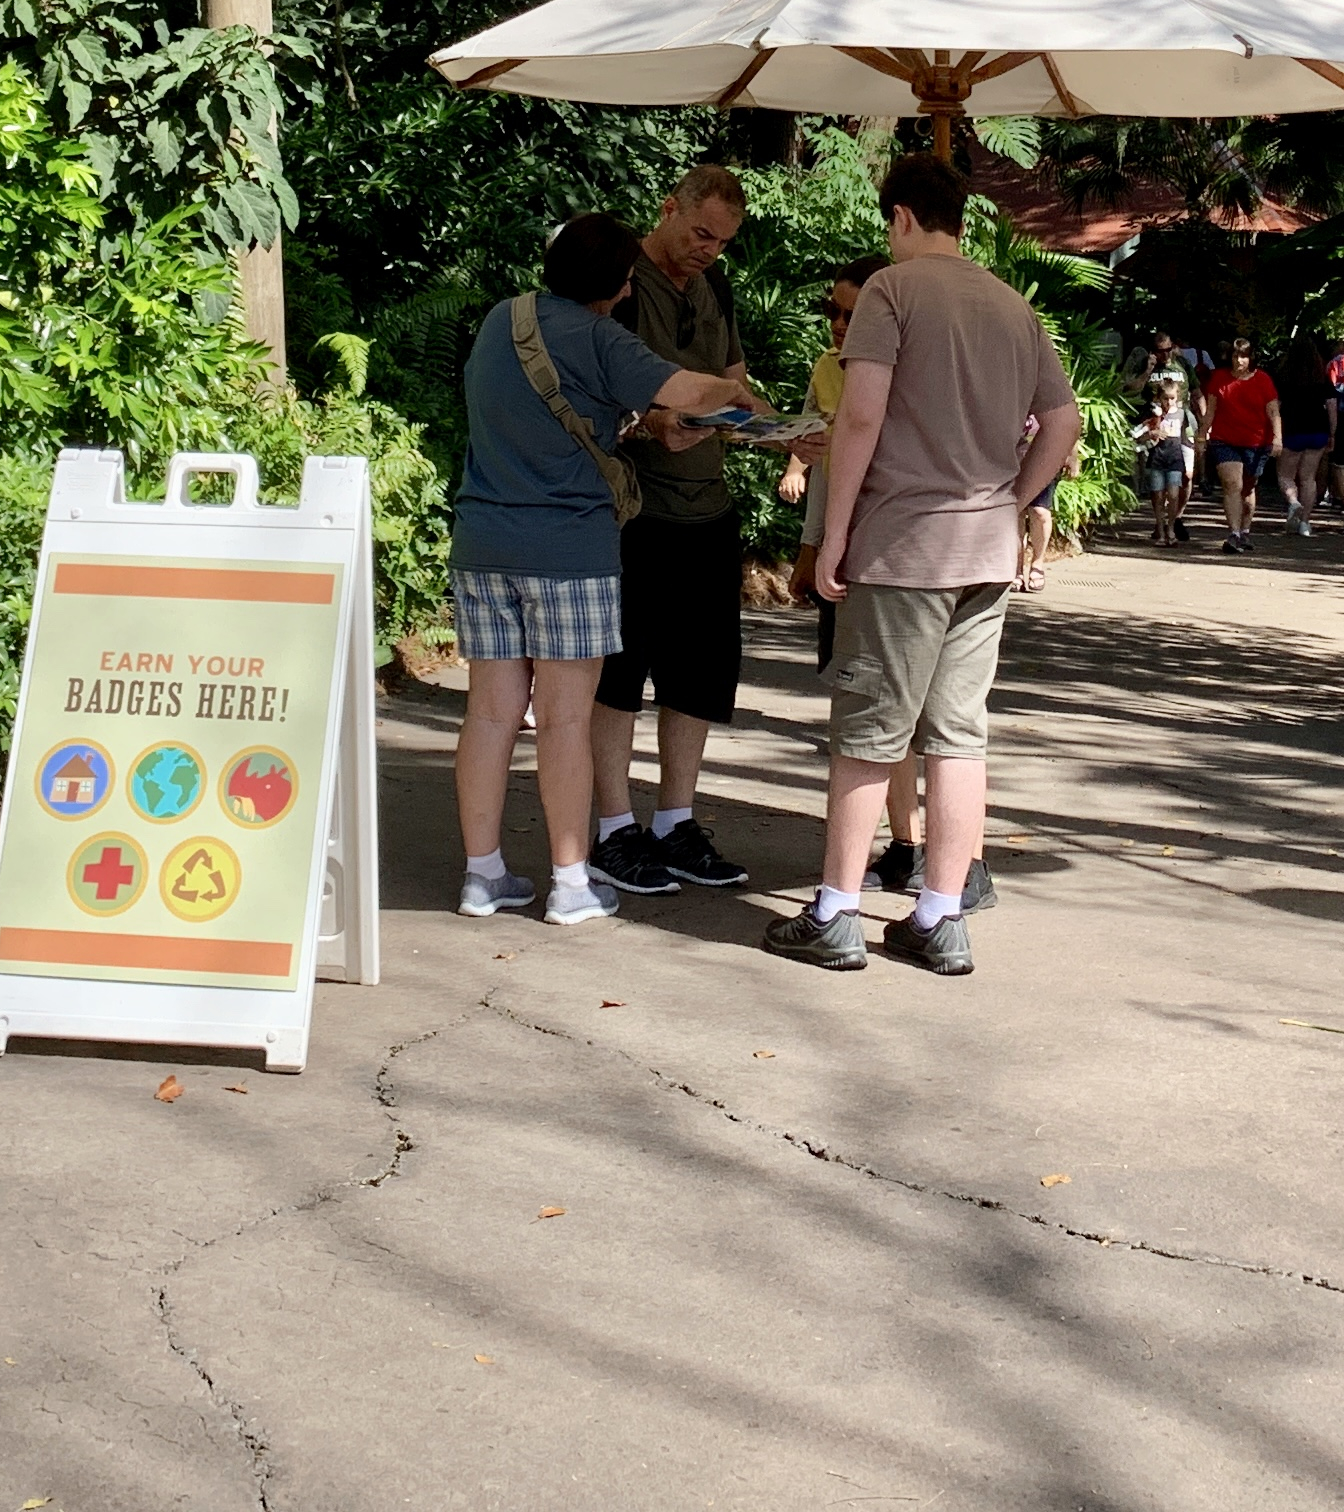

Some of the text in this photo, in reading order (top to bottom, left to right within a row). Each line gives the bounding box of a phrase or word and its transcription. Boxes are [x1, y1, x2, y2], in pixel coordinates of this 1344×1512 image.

[99, 650, 265, 678] EARN YOUR
[64, 677, 290, 723] BADGES HERE!
